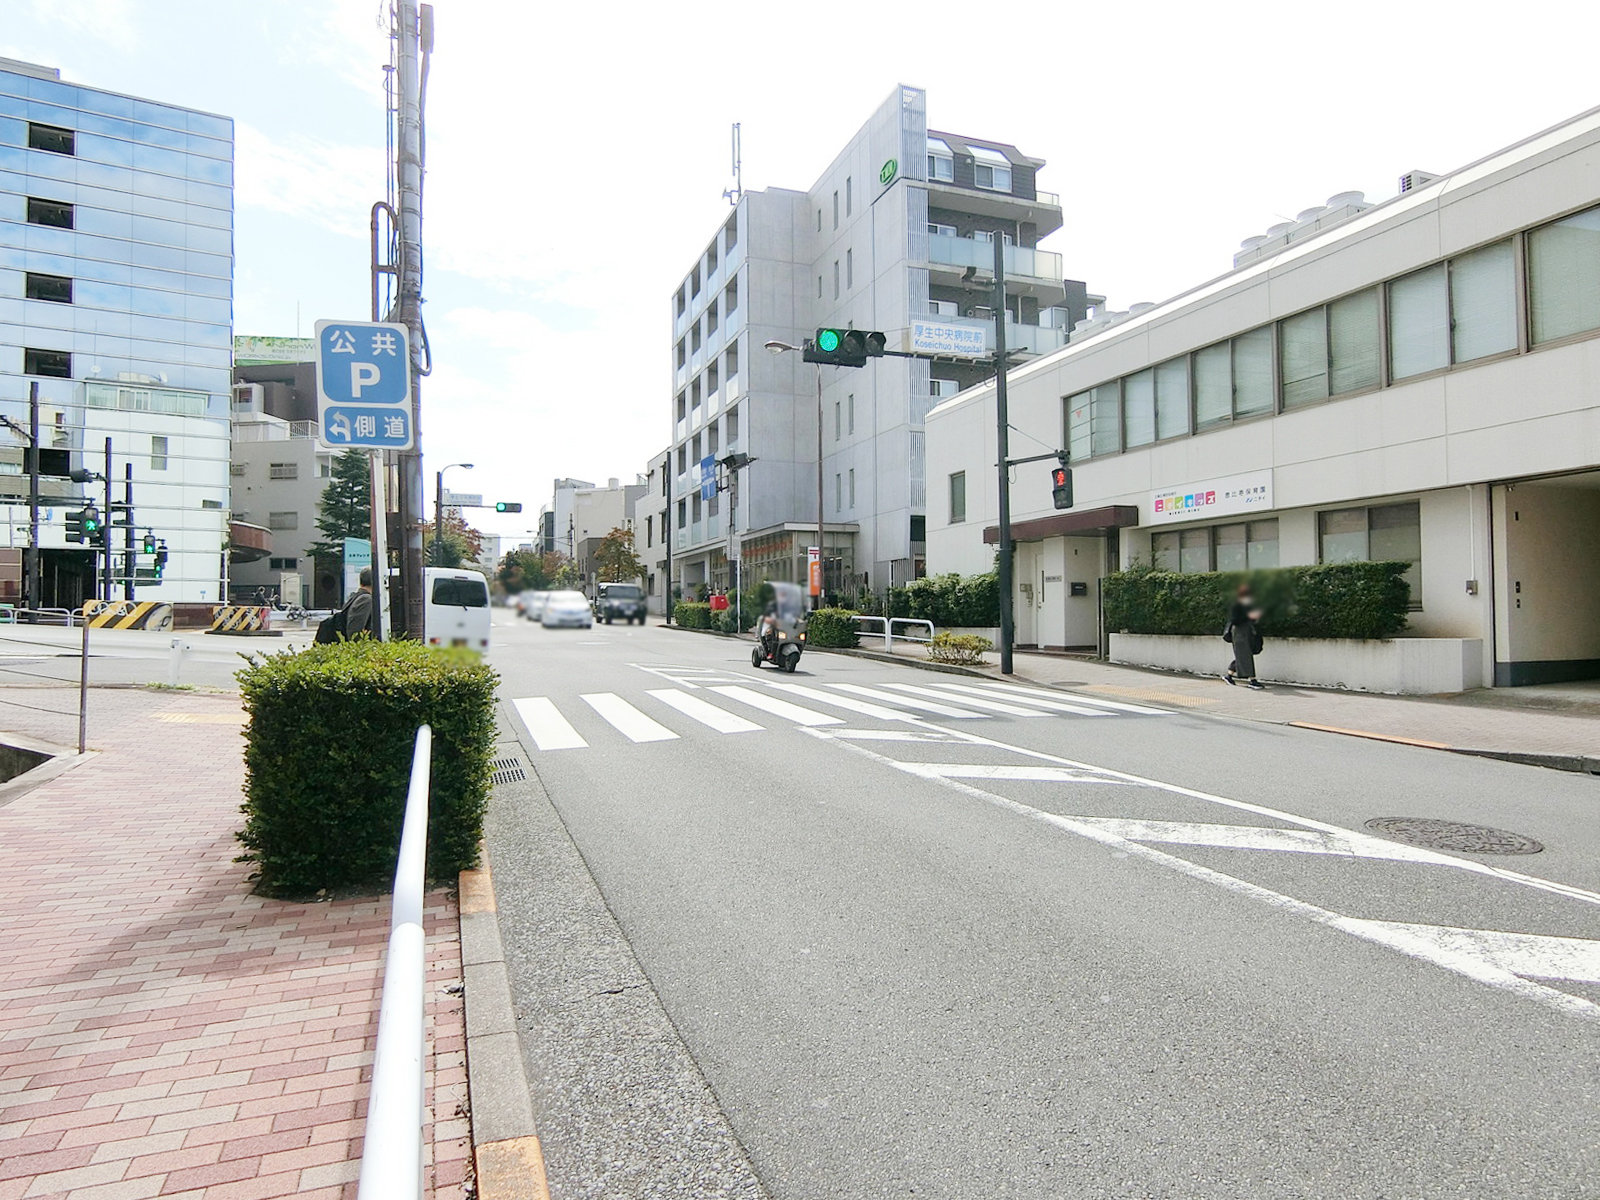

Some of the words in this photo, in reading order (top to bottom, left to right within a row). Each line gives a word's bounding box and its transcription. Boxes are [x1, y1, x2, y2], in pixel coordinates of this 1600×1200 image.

[329, 330, 397, 357] 公共
[914, 325, 983, 344] 厚生中央病院前
[914, 338, 952, 350] Koseichuo
[953, 342, 982, 354] Hospital
[350, 361, 381, 398] P
[354, 415, 406, 439] 側道
